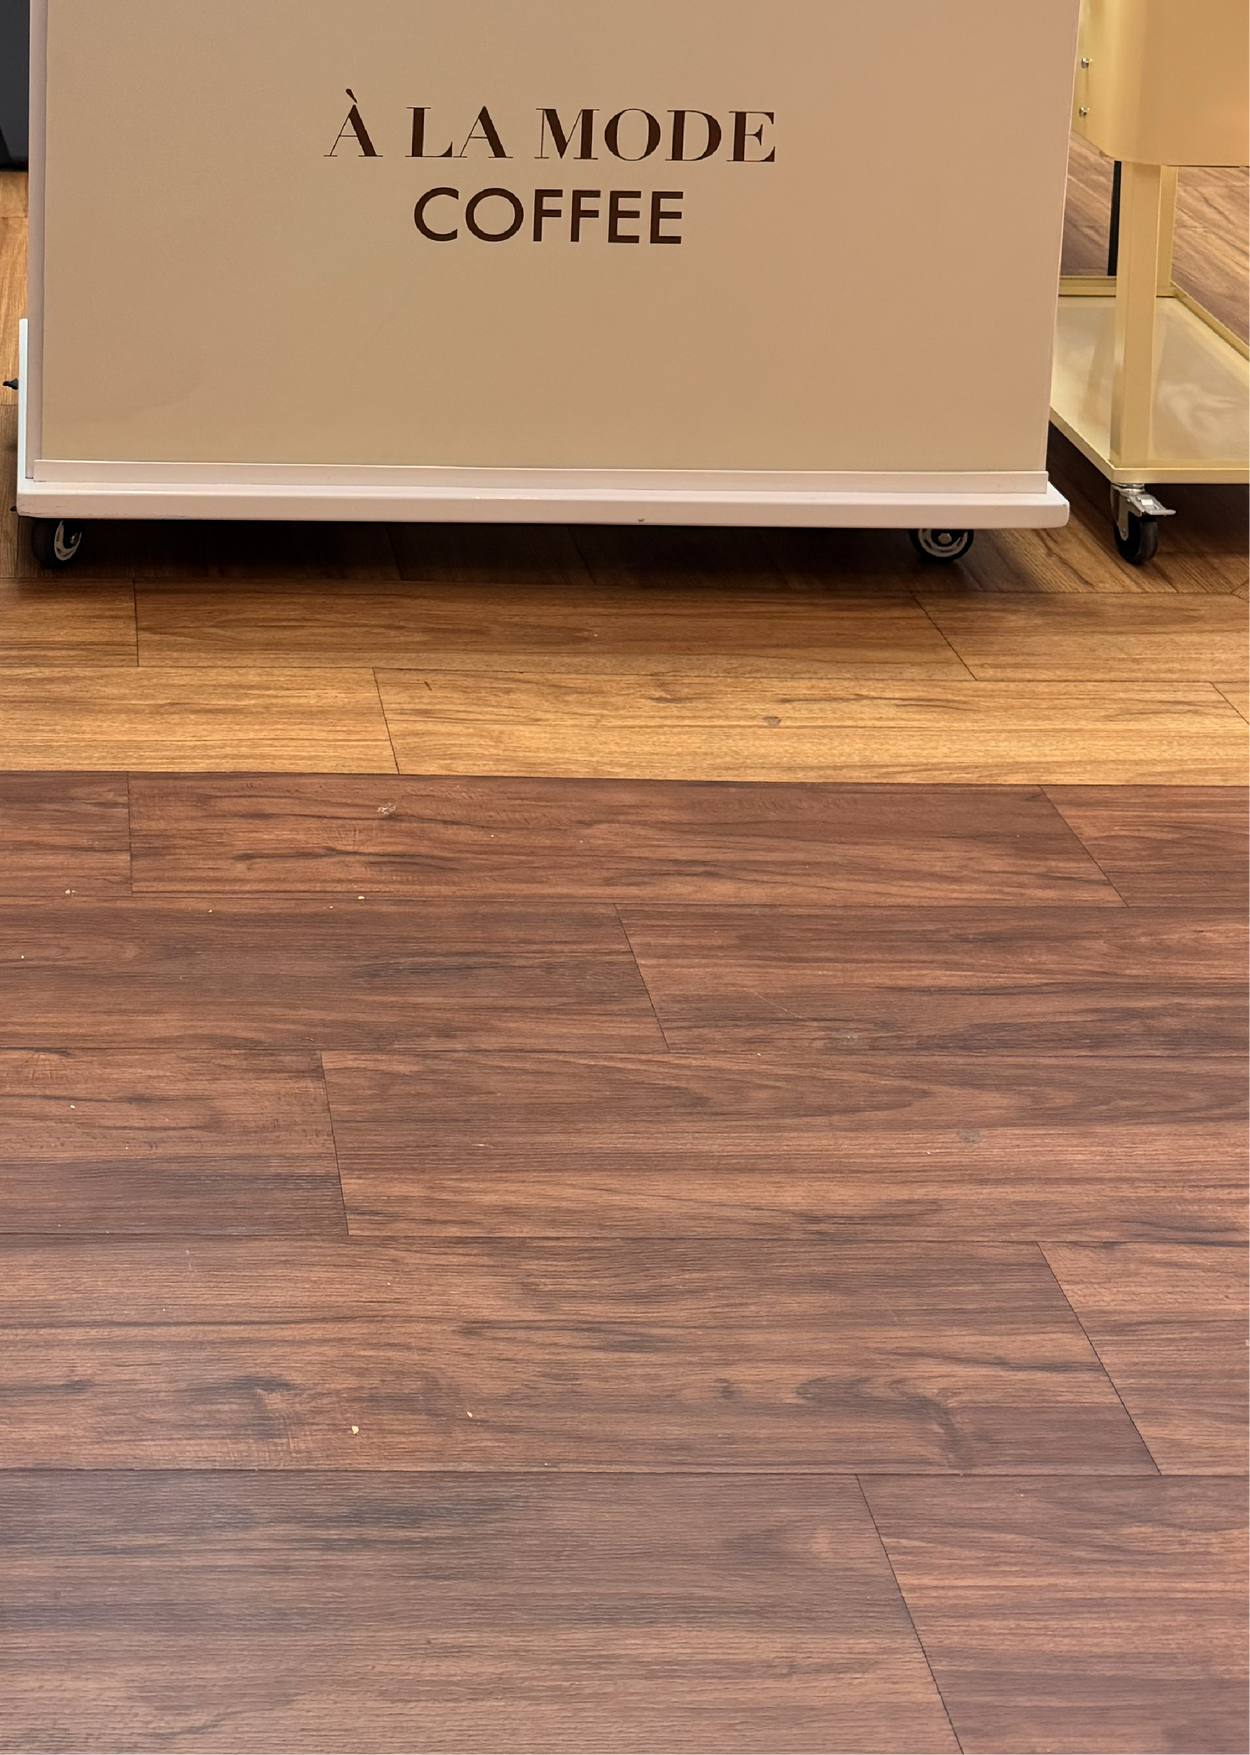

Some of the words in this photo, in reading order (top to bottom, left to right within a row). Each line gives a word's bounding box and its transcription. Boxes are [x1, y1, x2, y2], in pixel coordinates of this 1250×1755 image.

[323, 88, 383, 157] À
[405, 106, 513, 158] LA
[534, 108, 775, 162] MODE
[414, 187, 683, 244] COFFEE
